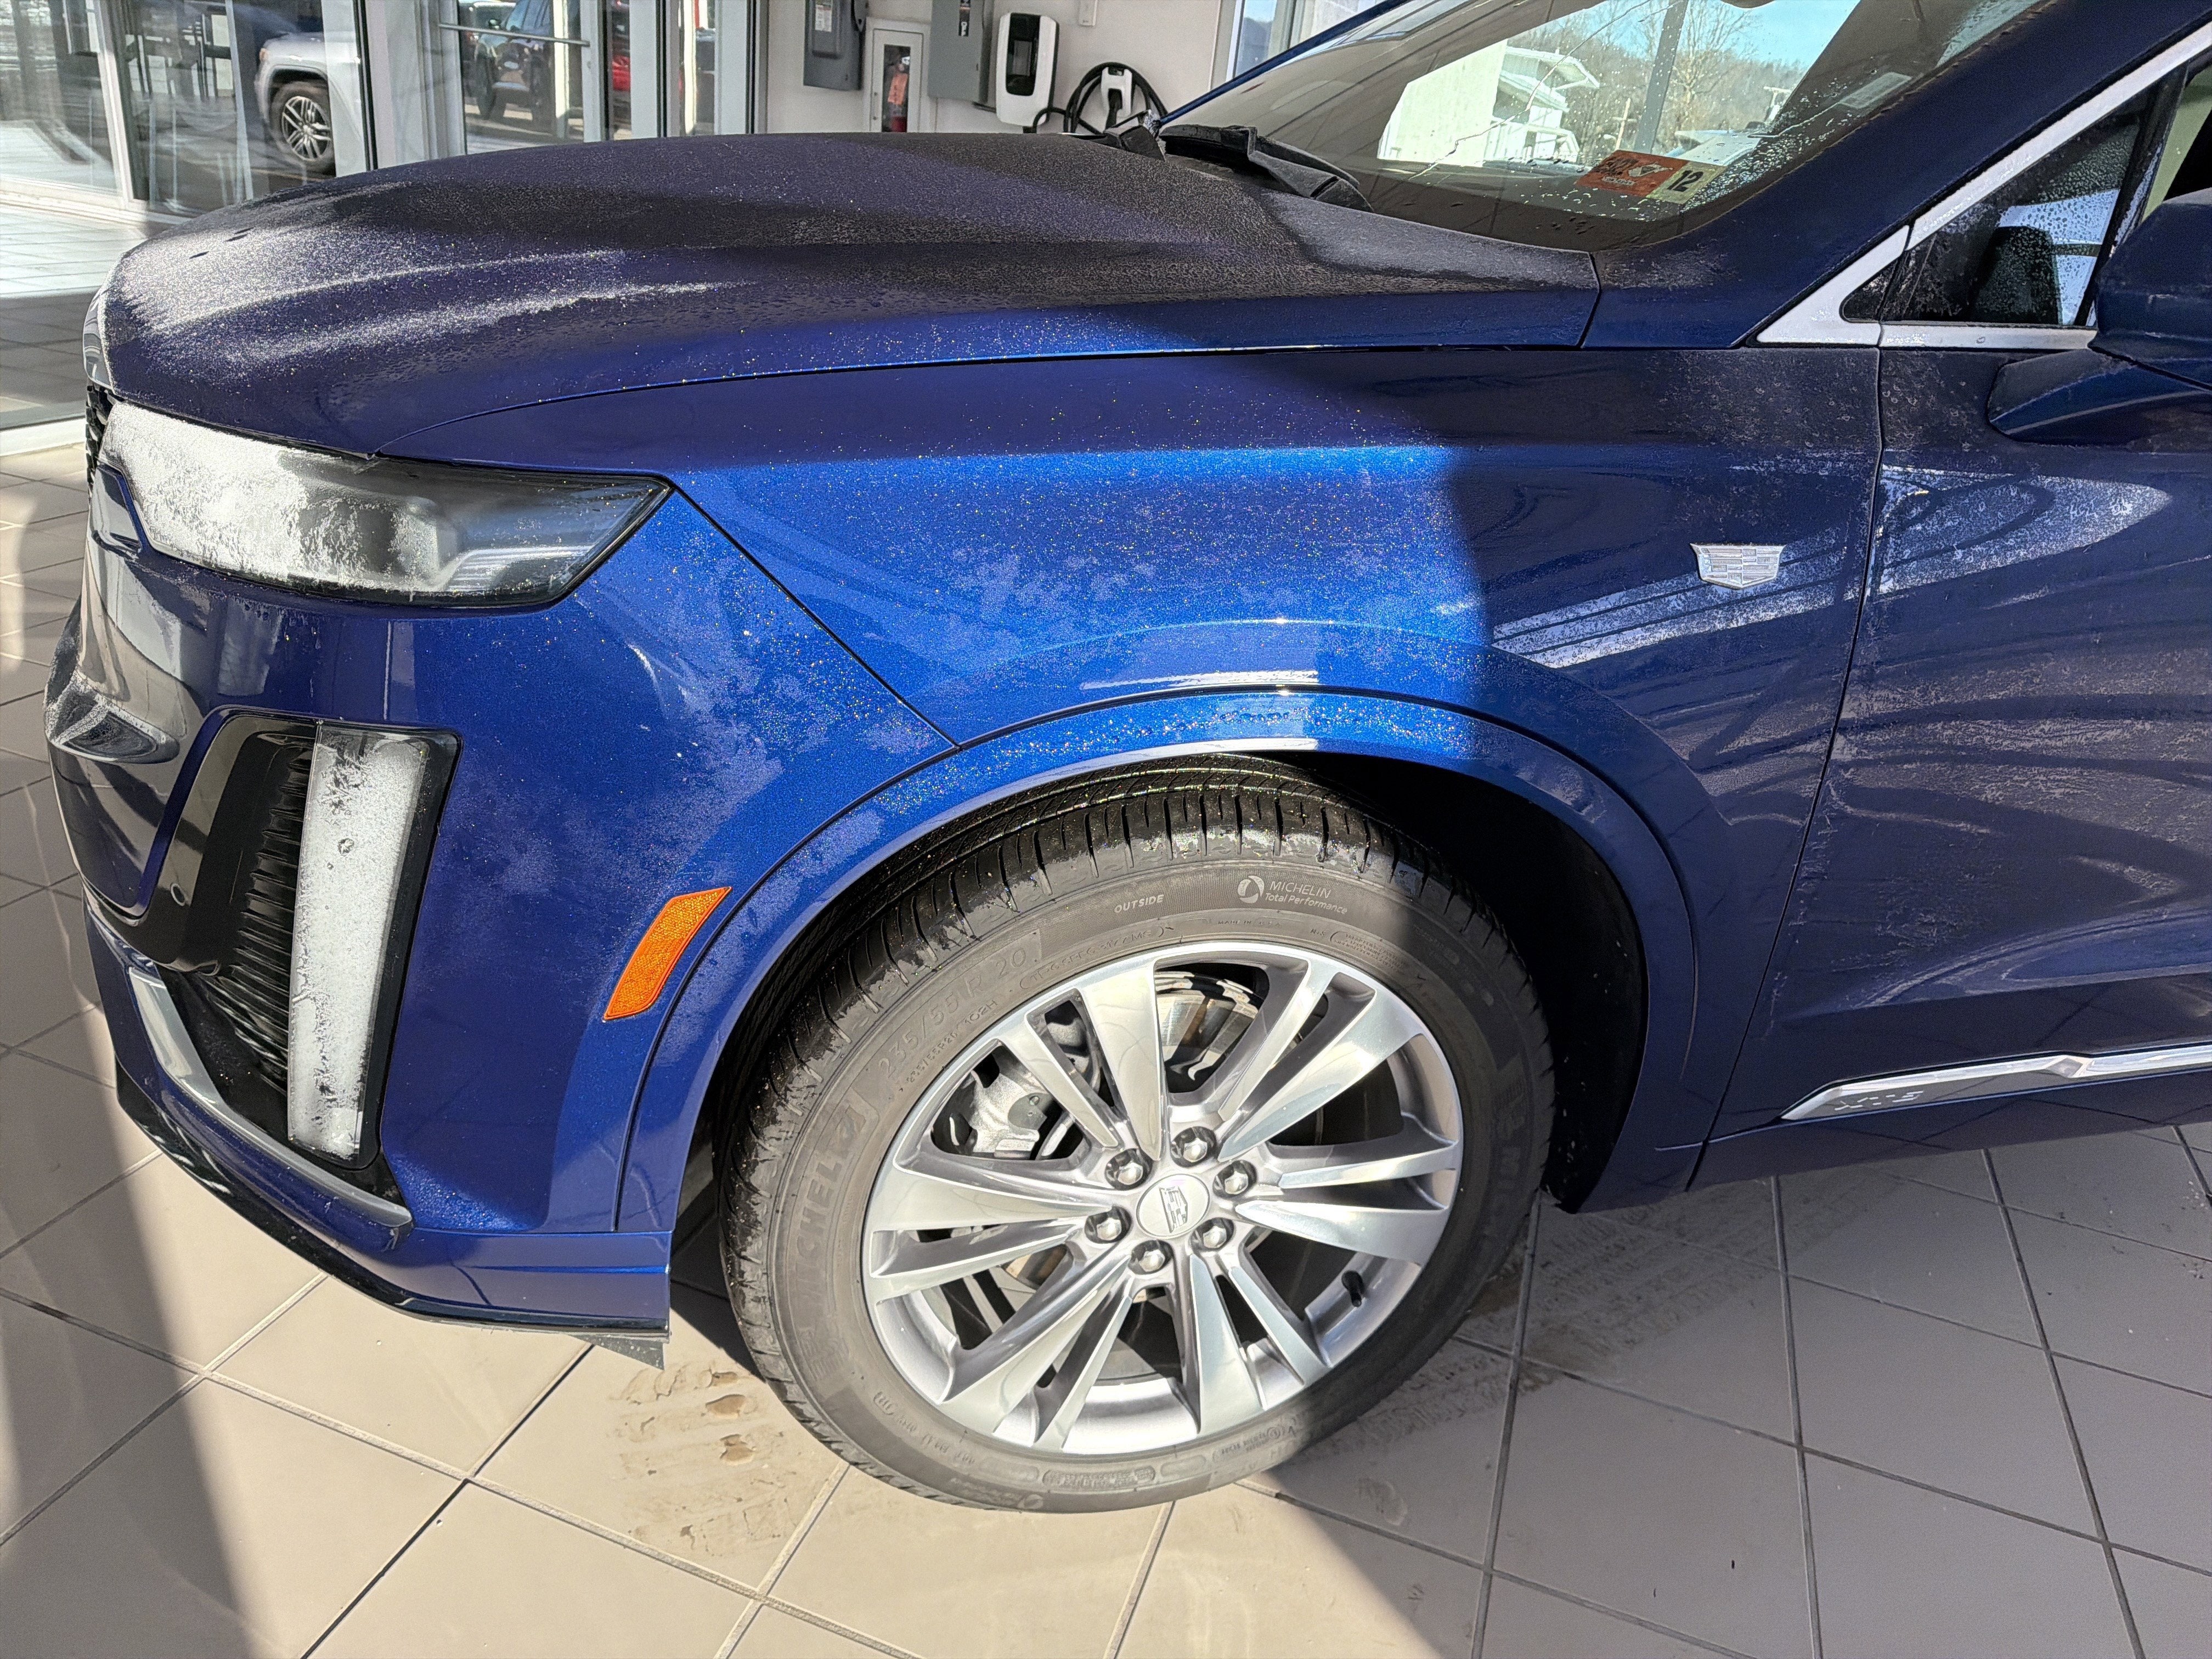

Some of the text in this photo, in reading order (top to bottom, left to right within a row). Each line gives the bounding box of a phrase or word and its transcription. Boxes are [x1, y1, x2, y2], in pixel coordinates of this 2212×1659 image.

[1667, 170, 1704, 192] 12
[1269, 881, 1331, 899] MICHELIN
[1114, 894, 1165, 913] OUTSIDE
[1265, 893, 1348, 915] Total Performance
